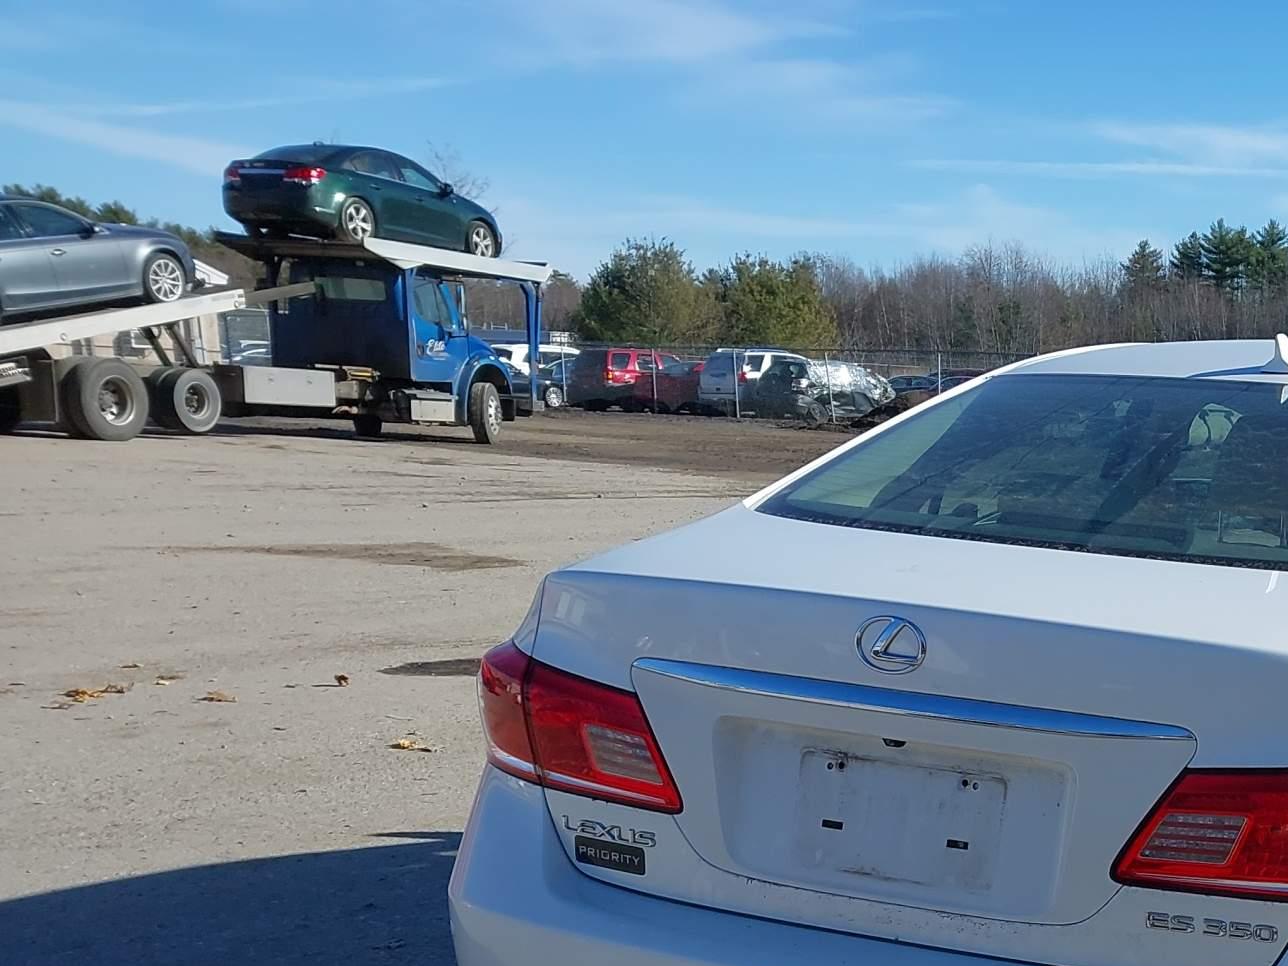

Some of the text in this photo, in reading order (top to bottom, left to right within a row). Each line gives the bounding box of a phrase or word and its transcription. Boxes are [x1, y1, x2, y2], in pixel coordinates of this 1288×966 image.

[562, 814, 657, 848] LEXUS
[578, 845, 641, 865] PRIORITY
[1146, 911, 1279, 944] ES 350
